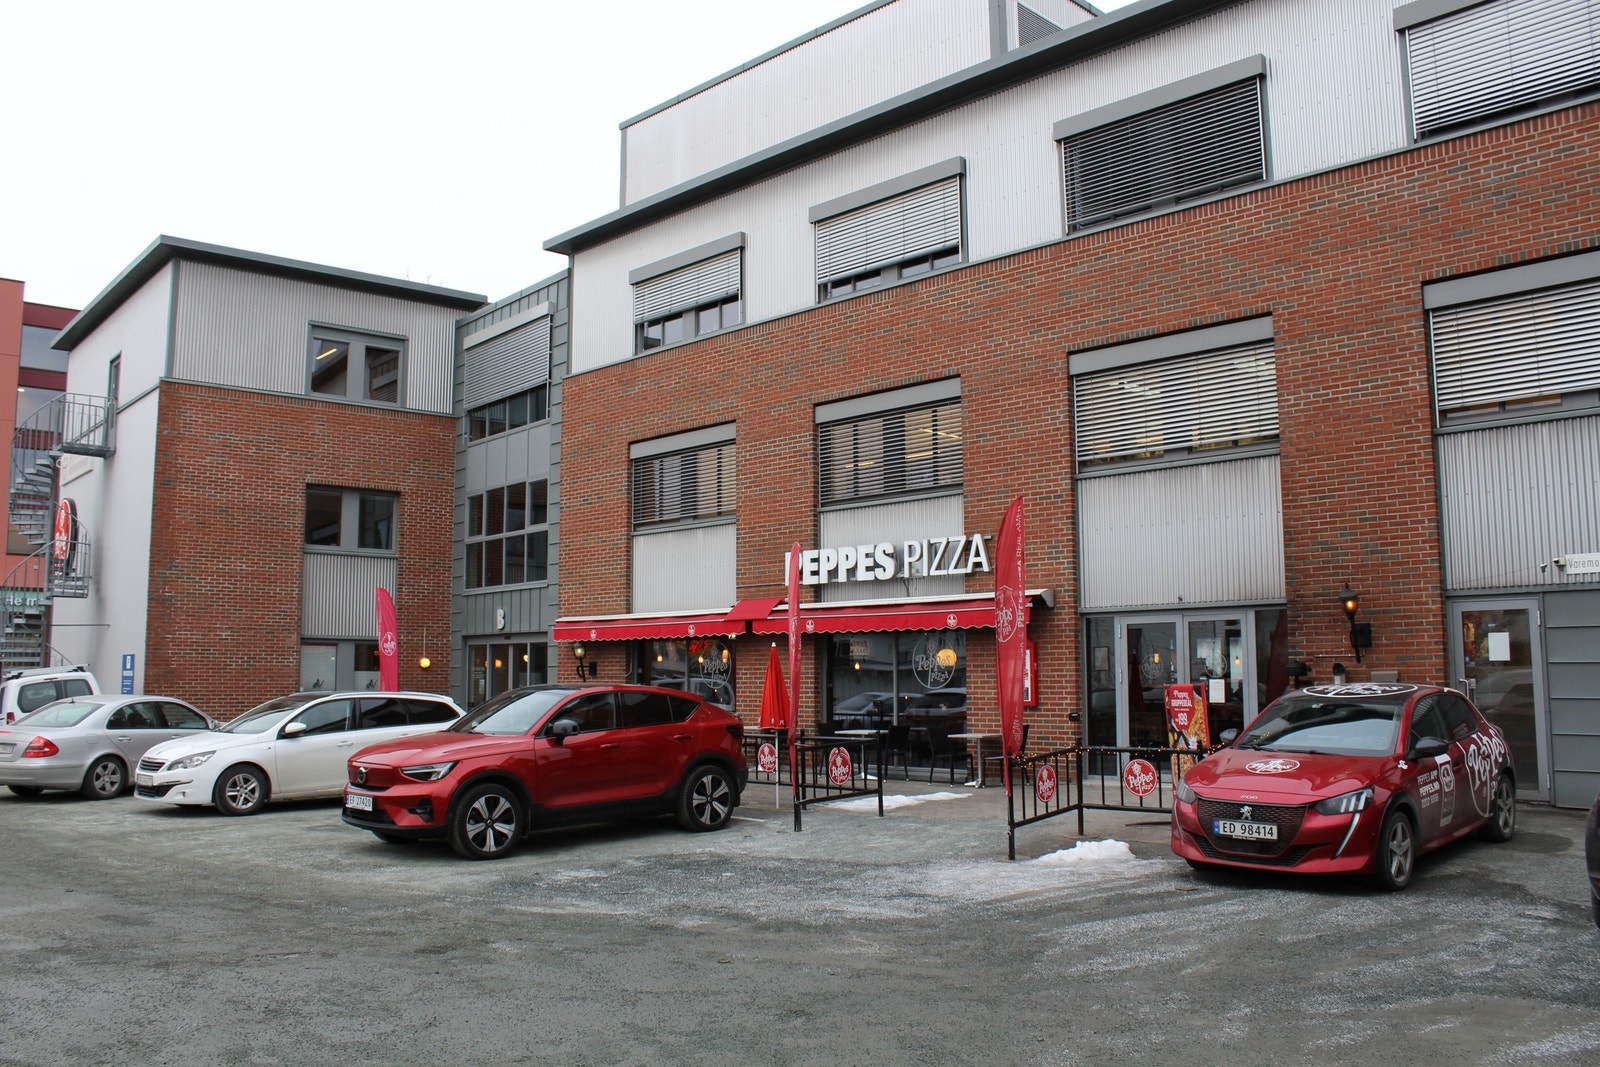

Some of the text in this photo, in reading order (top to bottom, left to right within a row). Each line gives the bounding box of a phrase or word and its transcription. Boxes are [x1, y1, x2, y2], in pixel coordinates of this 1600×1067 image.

[903, 534, 991, 577] PIZZA
[496, 608, 505, 630] B
[1127, 772, 1154, 789] Peppes
[1222, 822, 1274, 837] ED 98414
